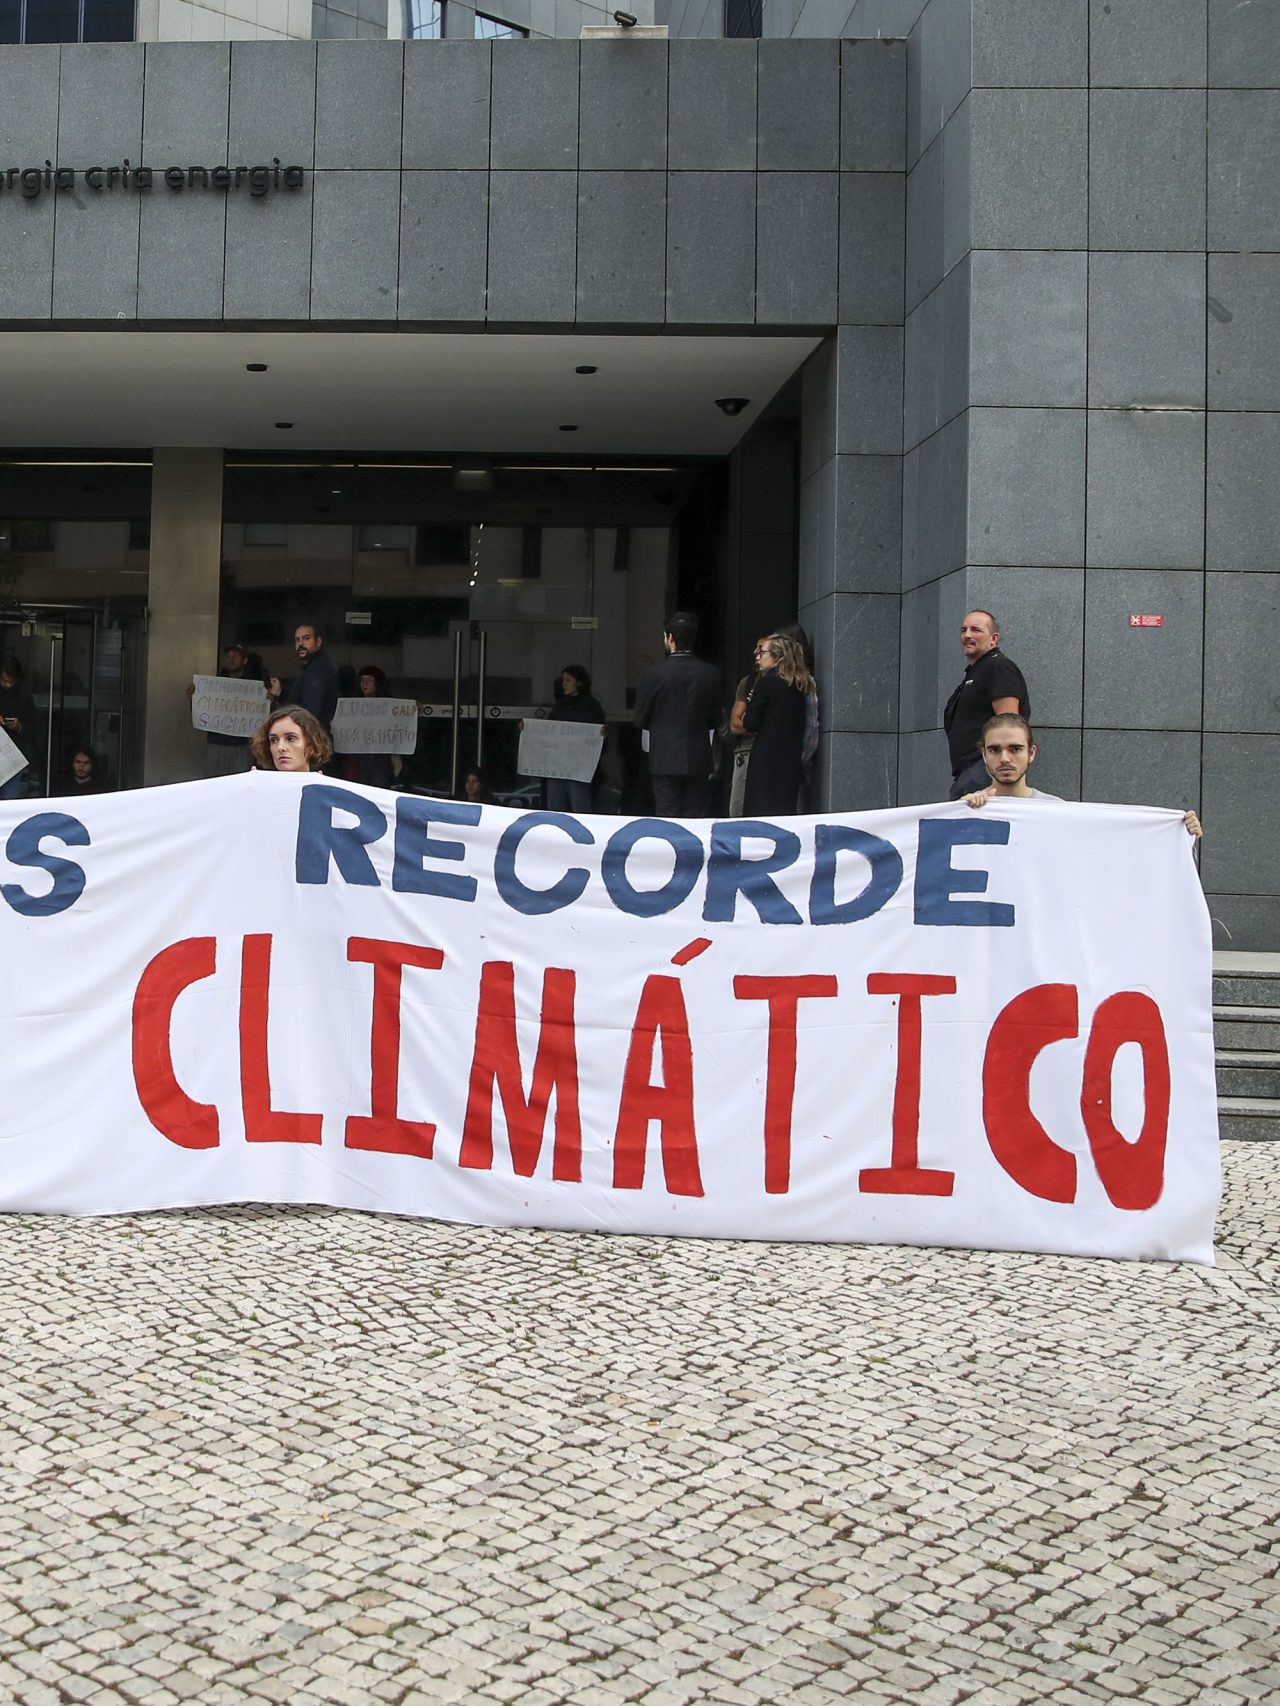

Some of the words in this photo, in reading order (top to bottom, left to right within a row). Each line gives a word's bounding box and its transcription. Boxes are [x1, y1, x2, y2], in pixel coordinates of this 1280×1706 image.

[84, 158, 153, 190] cria
[164, 157, 305, 197] energia
[296, 784, 1015, 927] RECORDE
[132, 934, 1171, 1211] CLIMÁTICO
